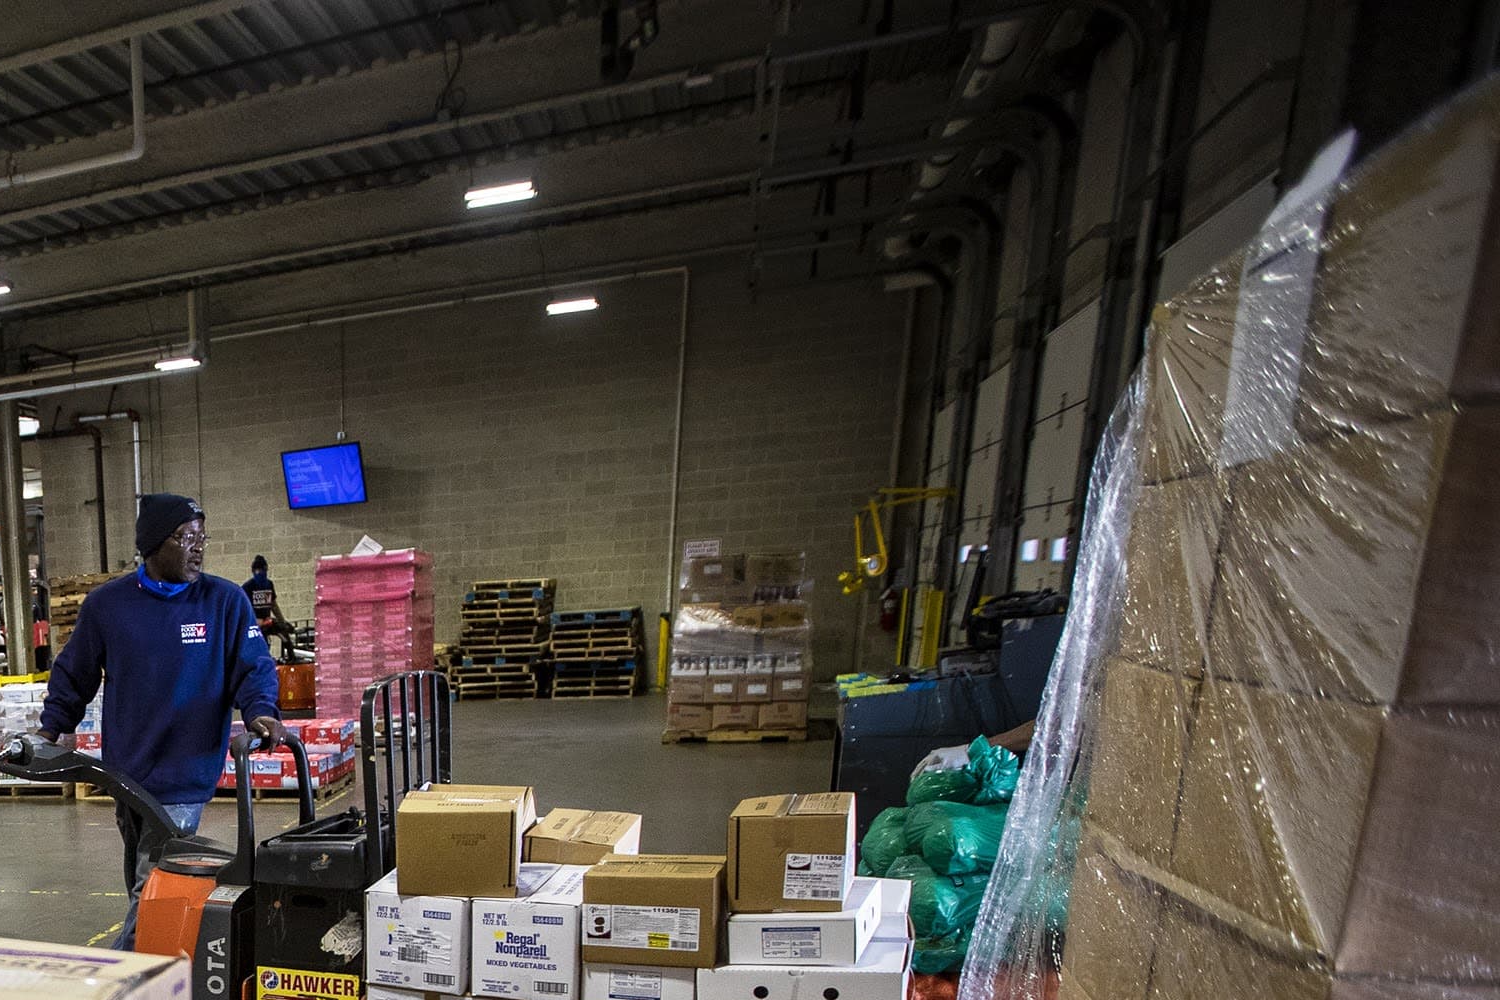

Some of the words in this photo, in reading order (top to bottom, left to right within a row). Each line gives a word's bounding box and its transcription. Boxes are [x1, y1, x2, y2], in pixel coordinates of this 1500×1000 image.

[483, 912, 494, 920] NET
[506, 931, 537, 947] Regal
[495, 941, 547, 958] Nonpareil
[486, 959, 508, 967] MIXED
[510, 961, 557, 970] VEGETABLES
[281, 973, 355, 996] HAWKER
